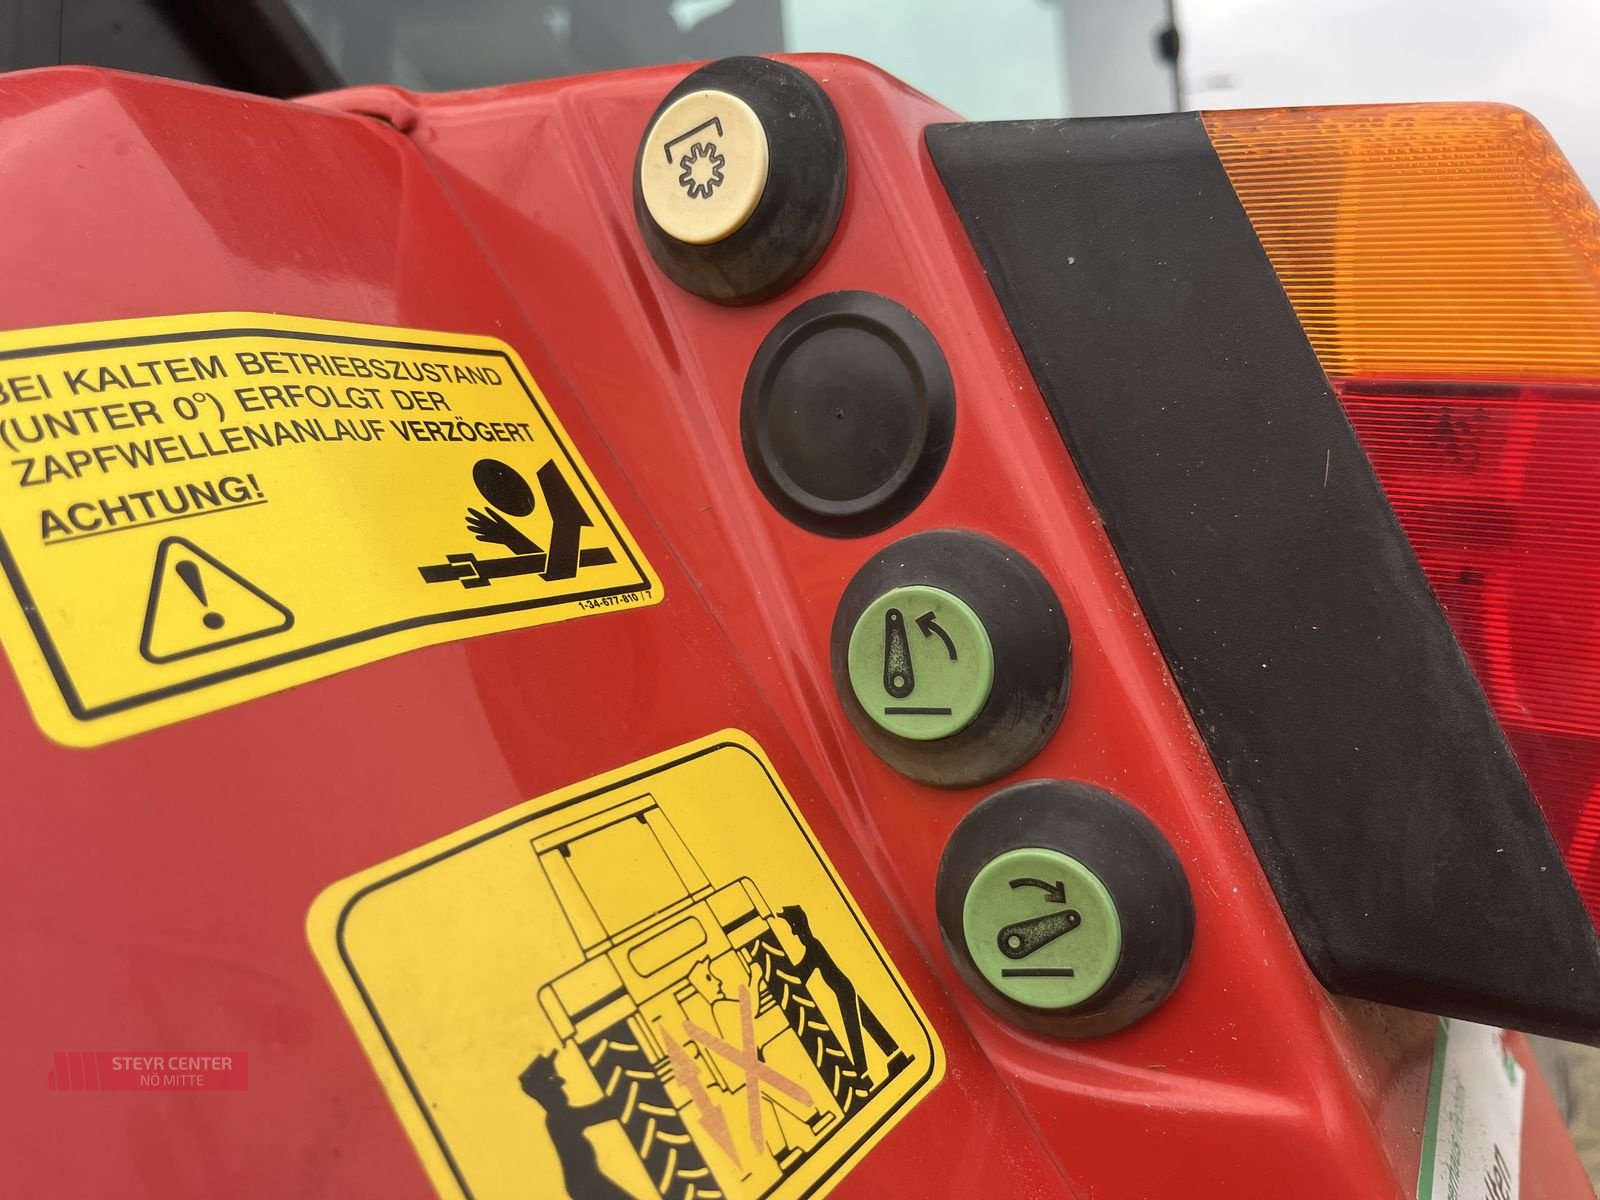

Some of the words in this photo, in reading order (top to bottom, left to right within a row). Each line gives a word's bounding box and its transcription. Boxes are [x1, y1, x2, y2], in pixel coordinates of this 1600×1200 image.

[63, 354, 228, 395] KALTEM
[235, 352, 502, 386] BETRIEBSZUSTAND
[0, 399, 165, 453] (UNTER
[234, 384, 385, 413] ERFOLGT
[391, 389, 452, 412] DER
[11, 418, 386, 488] ZAPFWELLENANLAUF
[389, 416, 535, 443] VERZÖGERT
[41, 473, 265, 539] ACHTUNG!
[578, 593, 638, 610] 1-34-677-810
